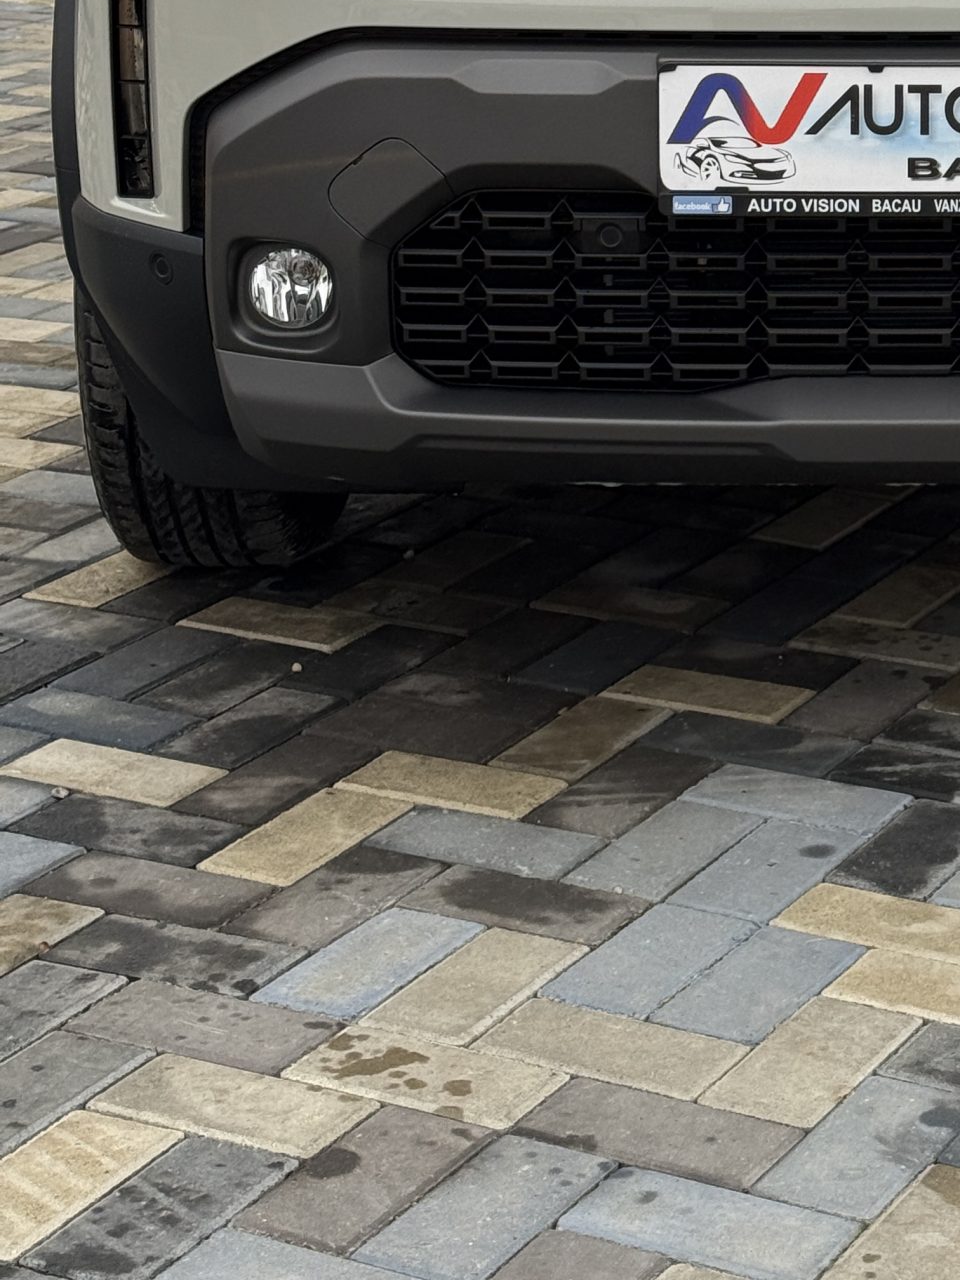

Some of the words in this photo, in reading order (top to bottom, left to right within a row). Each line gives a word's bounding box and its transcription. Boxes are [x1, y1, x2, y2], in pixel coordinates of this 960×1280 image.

[674, 201, 712, 211] facebook
[748, 198, 797, 213] AUTO
[801, 198, 860, 213] VISION
[872, 199, 921, 212] BACAU
